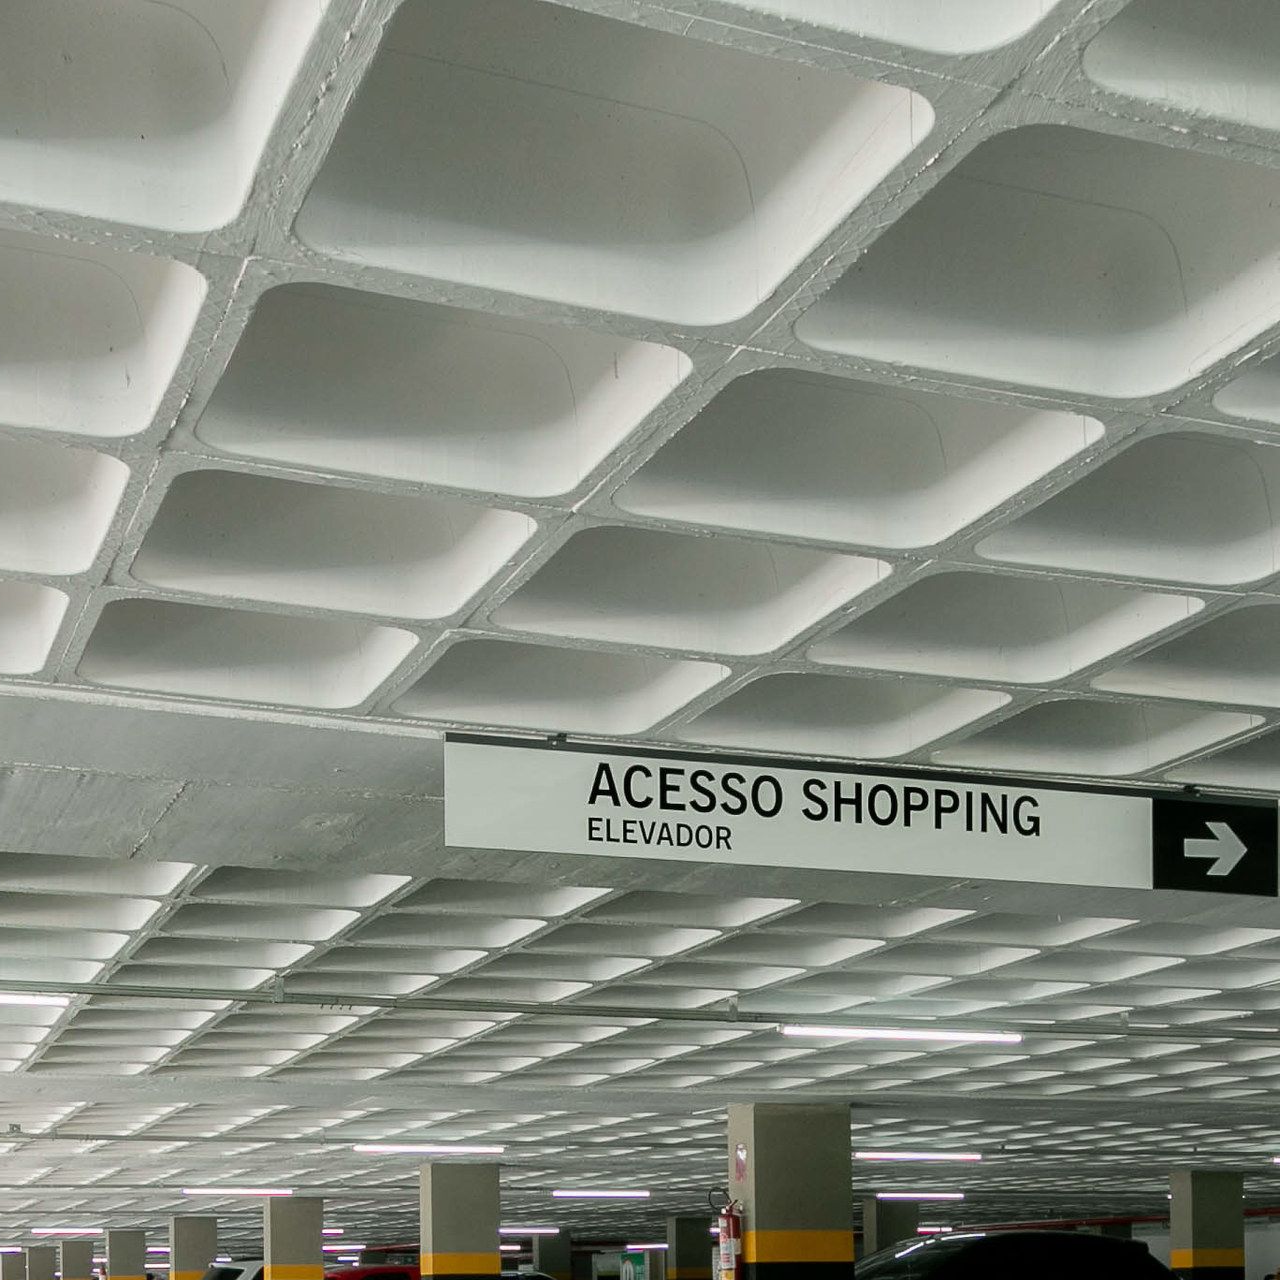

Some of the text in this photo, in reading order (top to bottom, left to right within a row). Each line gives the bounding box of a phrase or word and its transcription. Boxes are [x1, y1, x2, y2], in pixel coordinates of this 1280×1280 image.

[588, 762, 1040, 838] ACESSO SHOPPING
[588, 817, 732, 850] ELEVADOR
